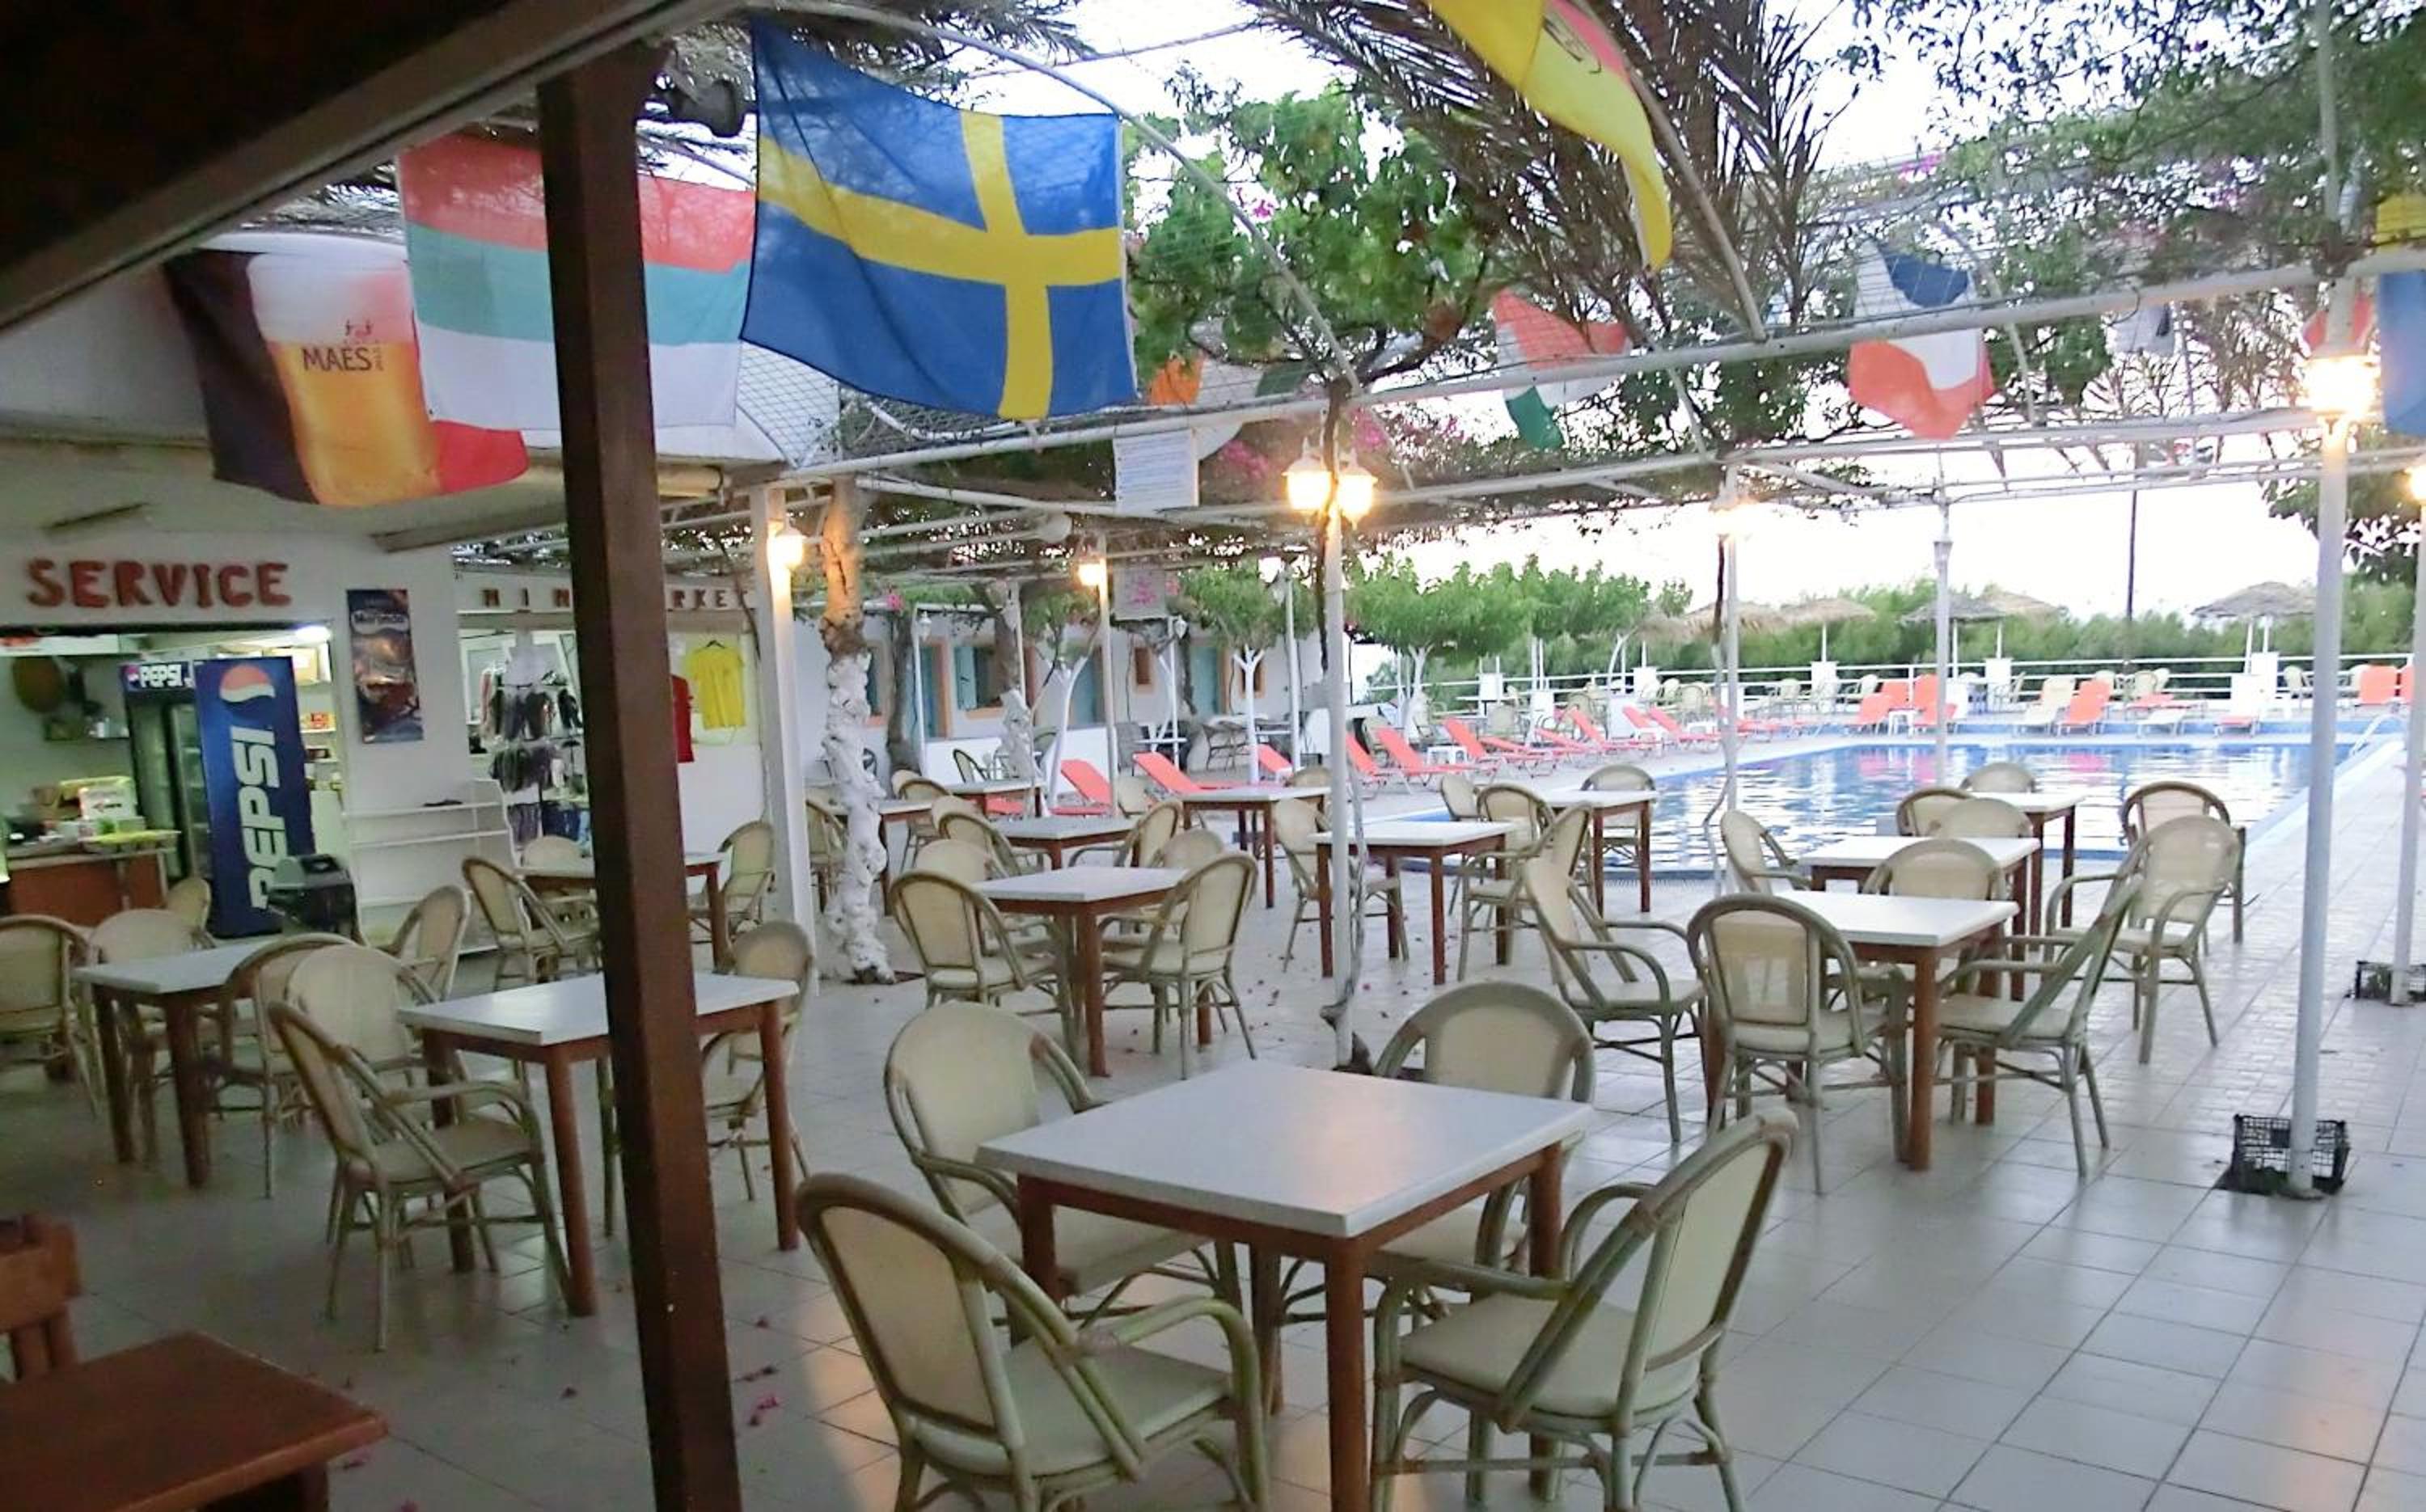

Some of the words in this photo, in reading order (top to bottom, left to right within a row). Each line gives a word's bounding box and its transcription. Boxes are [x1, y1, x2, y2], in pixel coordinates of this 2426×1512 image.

[302, 346, 372, 372] MAES
[27, 559, 292, 607] SERVICE
[140, 664, 183, 687] PEPSI
[230, 725, 286, 910] PEPSI
